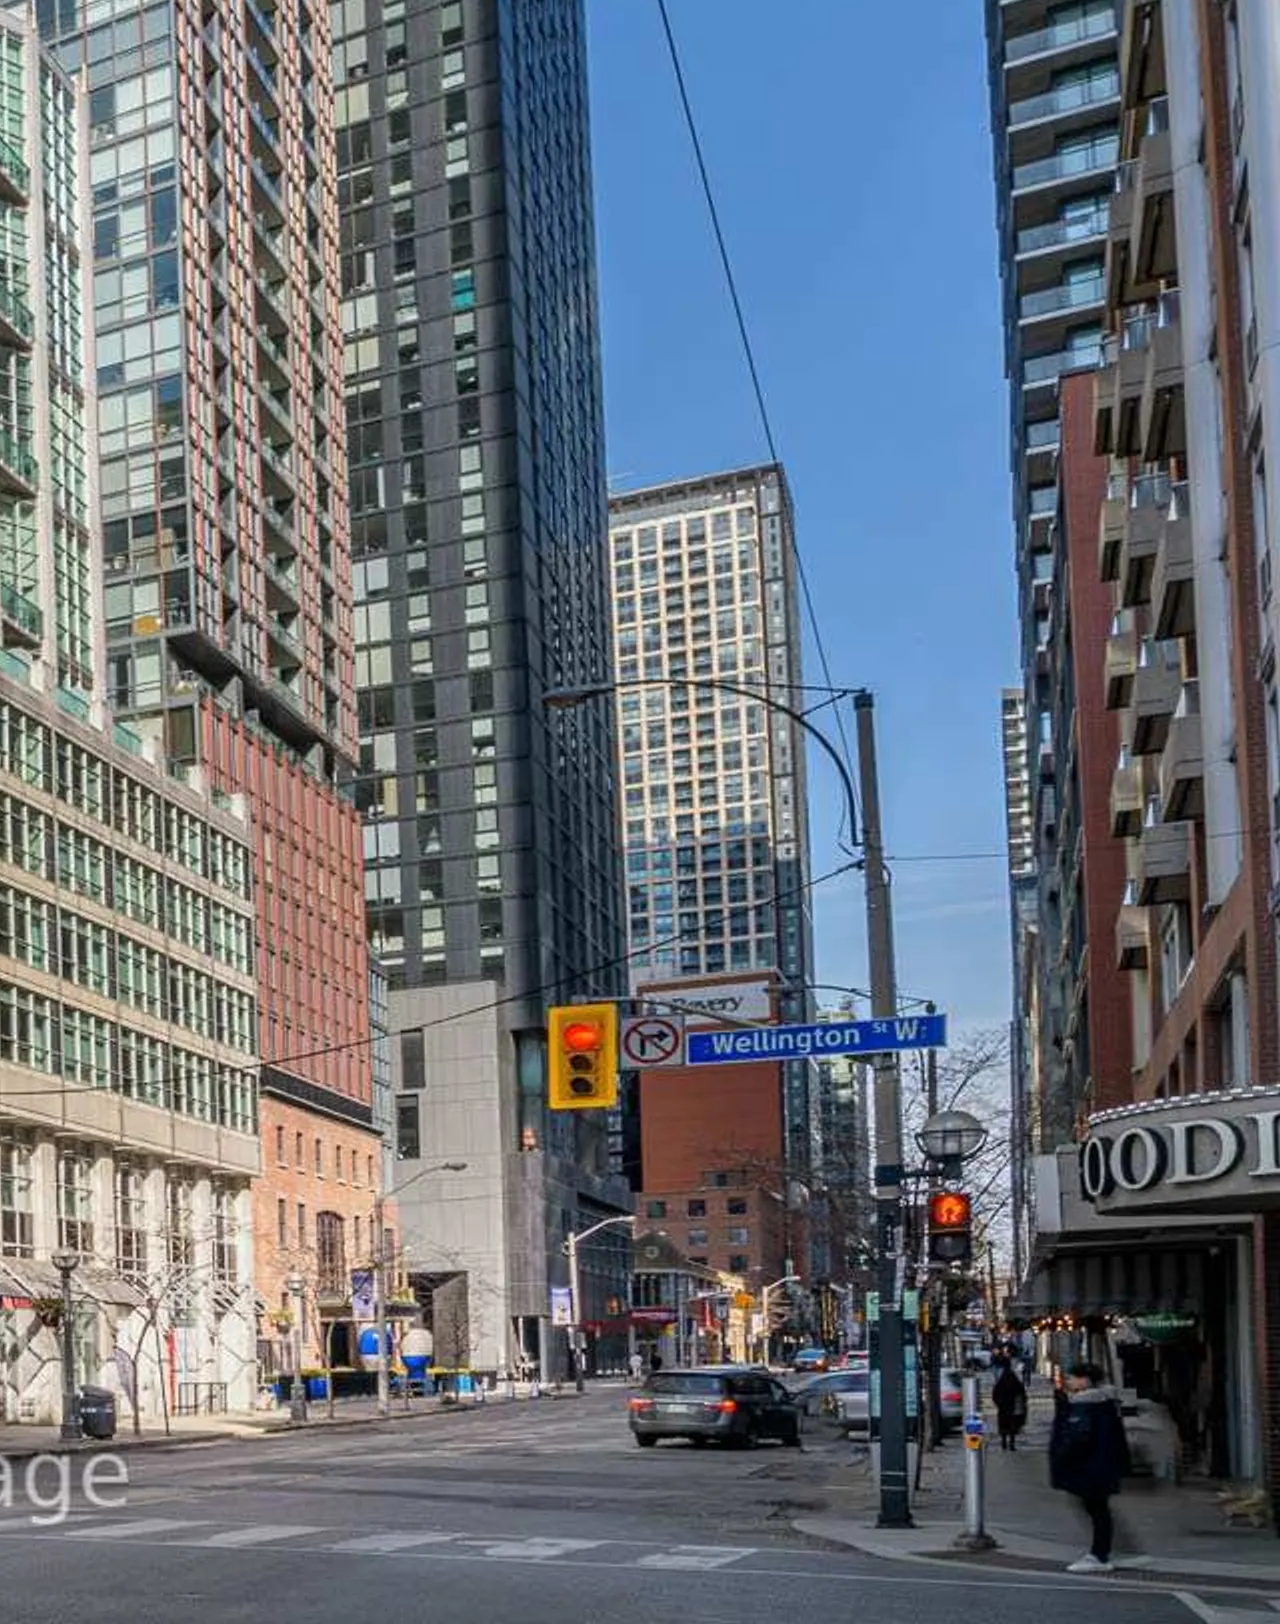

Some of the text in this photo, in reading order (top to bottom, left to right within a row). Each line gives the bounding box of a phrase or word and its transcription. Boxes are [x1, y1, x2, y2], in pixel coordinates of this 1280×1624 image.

[712, 1020, 920, 1055] Wellington St W
